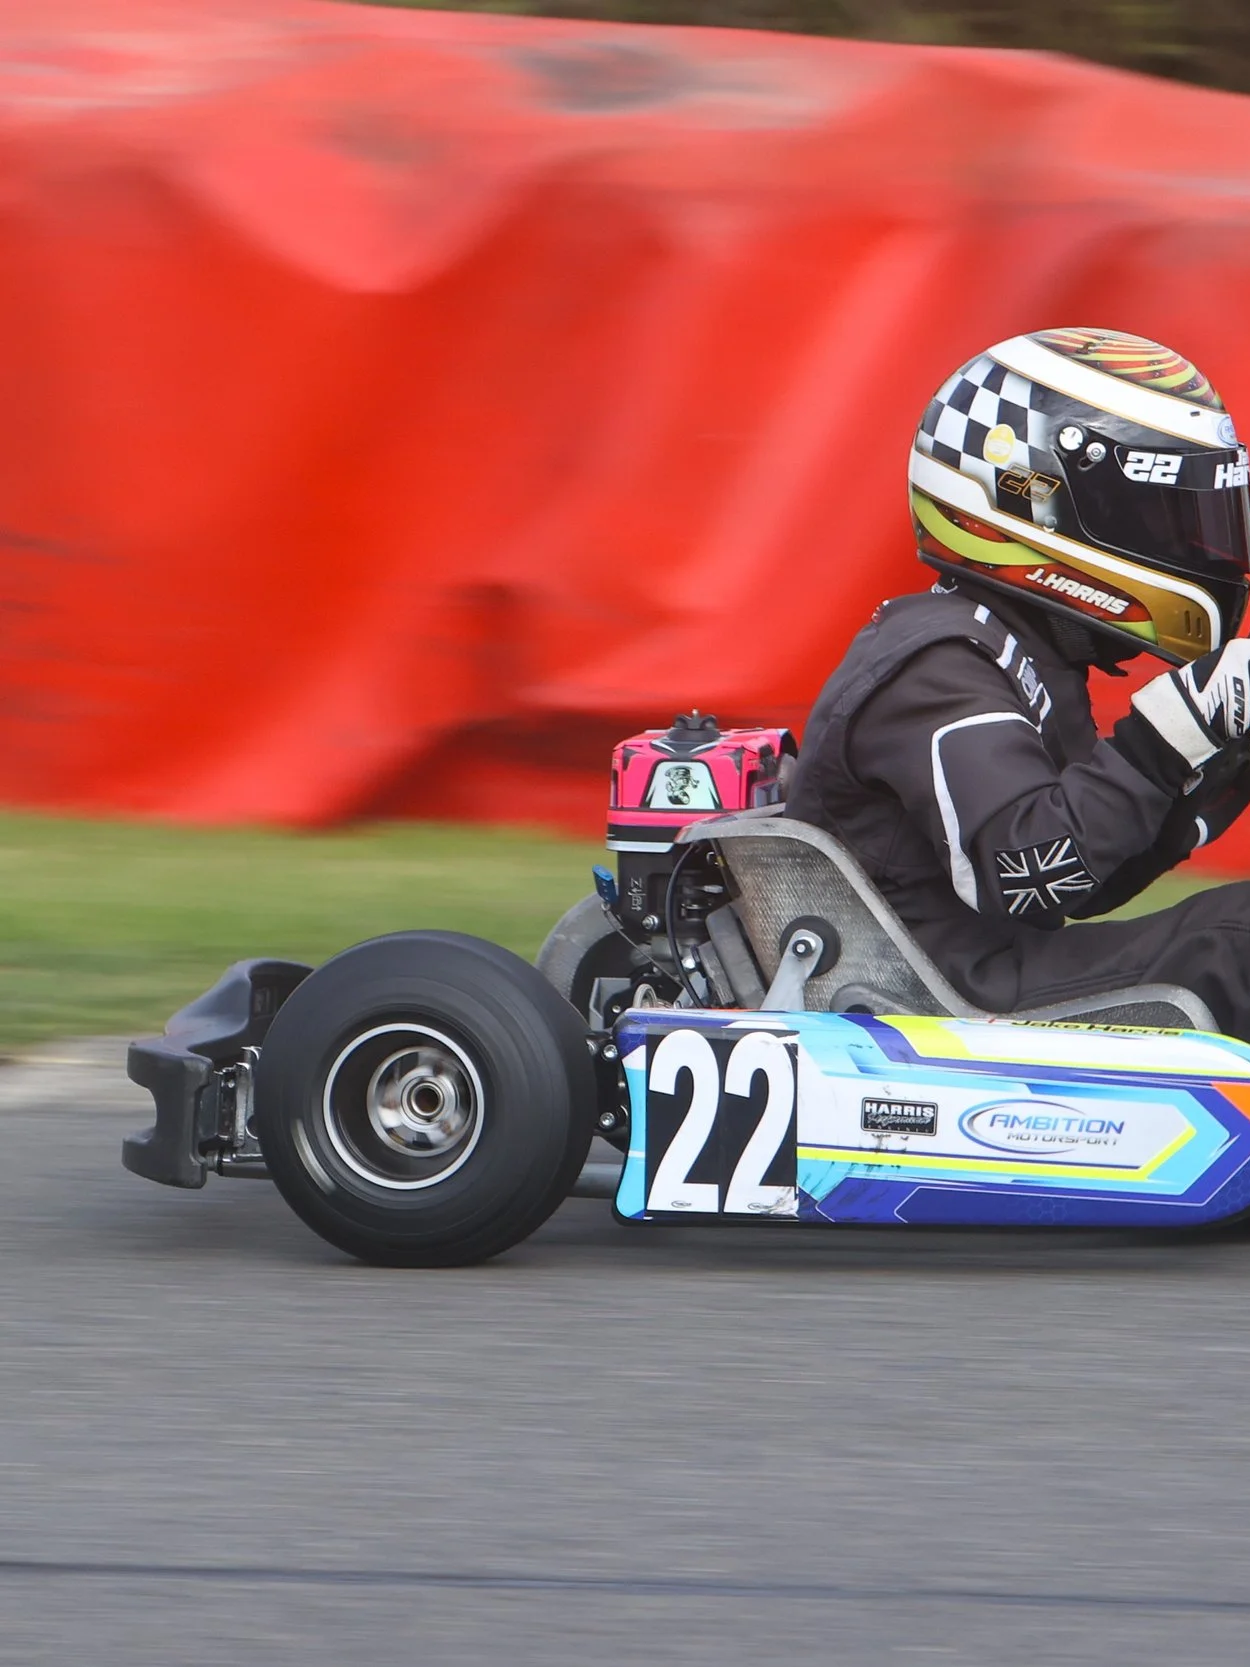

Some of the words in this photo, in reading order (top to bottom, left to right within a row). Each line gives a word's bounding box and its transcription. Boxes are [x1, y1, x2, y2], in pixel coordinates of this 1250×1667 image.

[997, 463, 1060, 502] 22
[1123, 451, 1183, 485] 22
[1025, 568, 1130, 615] J.HARRIS
[1233, 676, 1246, 737] OMP
[1011, 1020, 1080, 1031] Jake
[1087, 1023, 1181, 1037] Harris
[647, 1029, 795, 1213] 22
[865, 1102, 935, 1119] HARRIS
[989, 1114, 1125, 1135] AMBITION
[1007, 1132, 1119, 1146] MOTORSPORT
